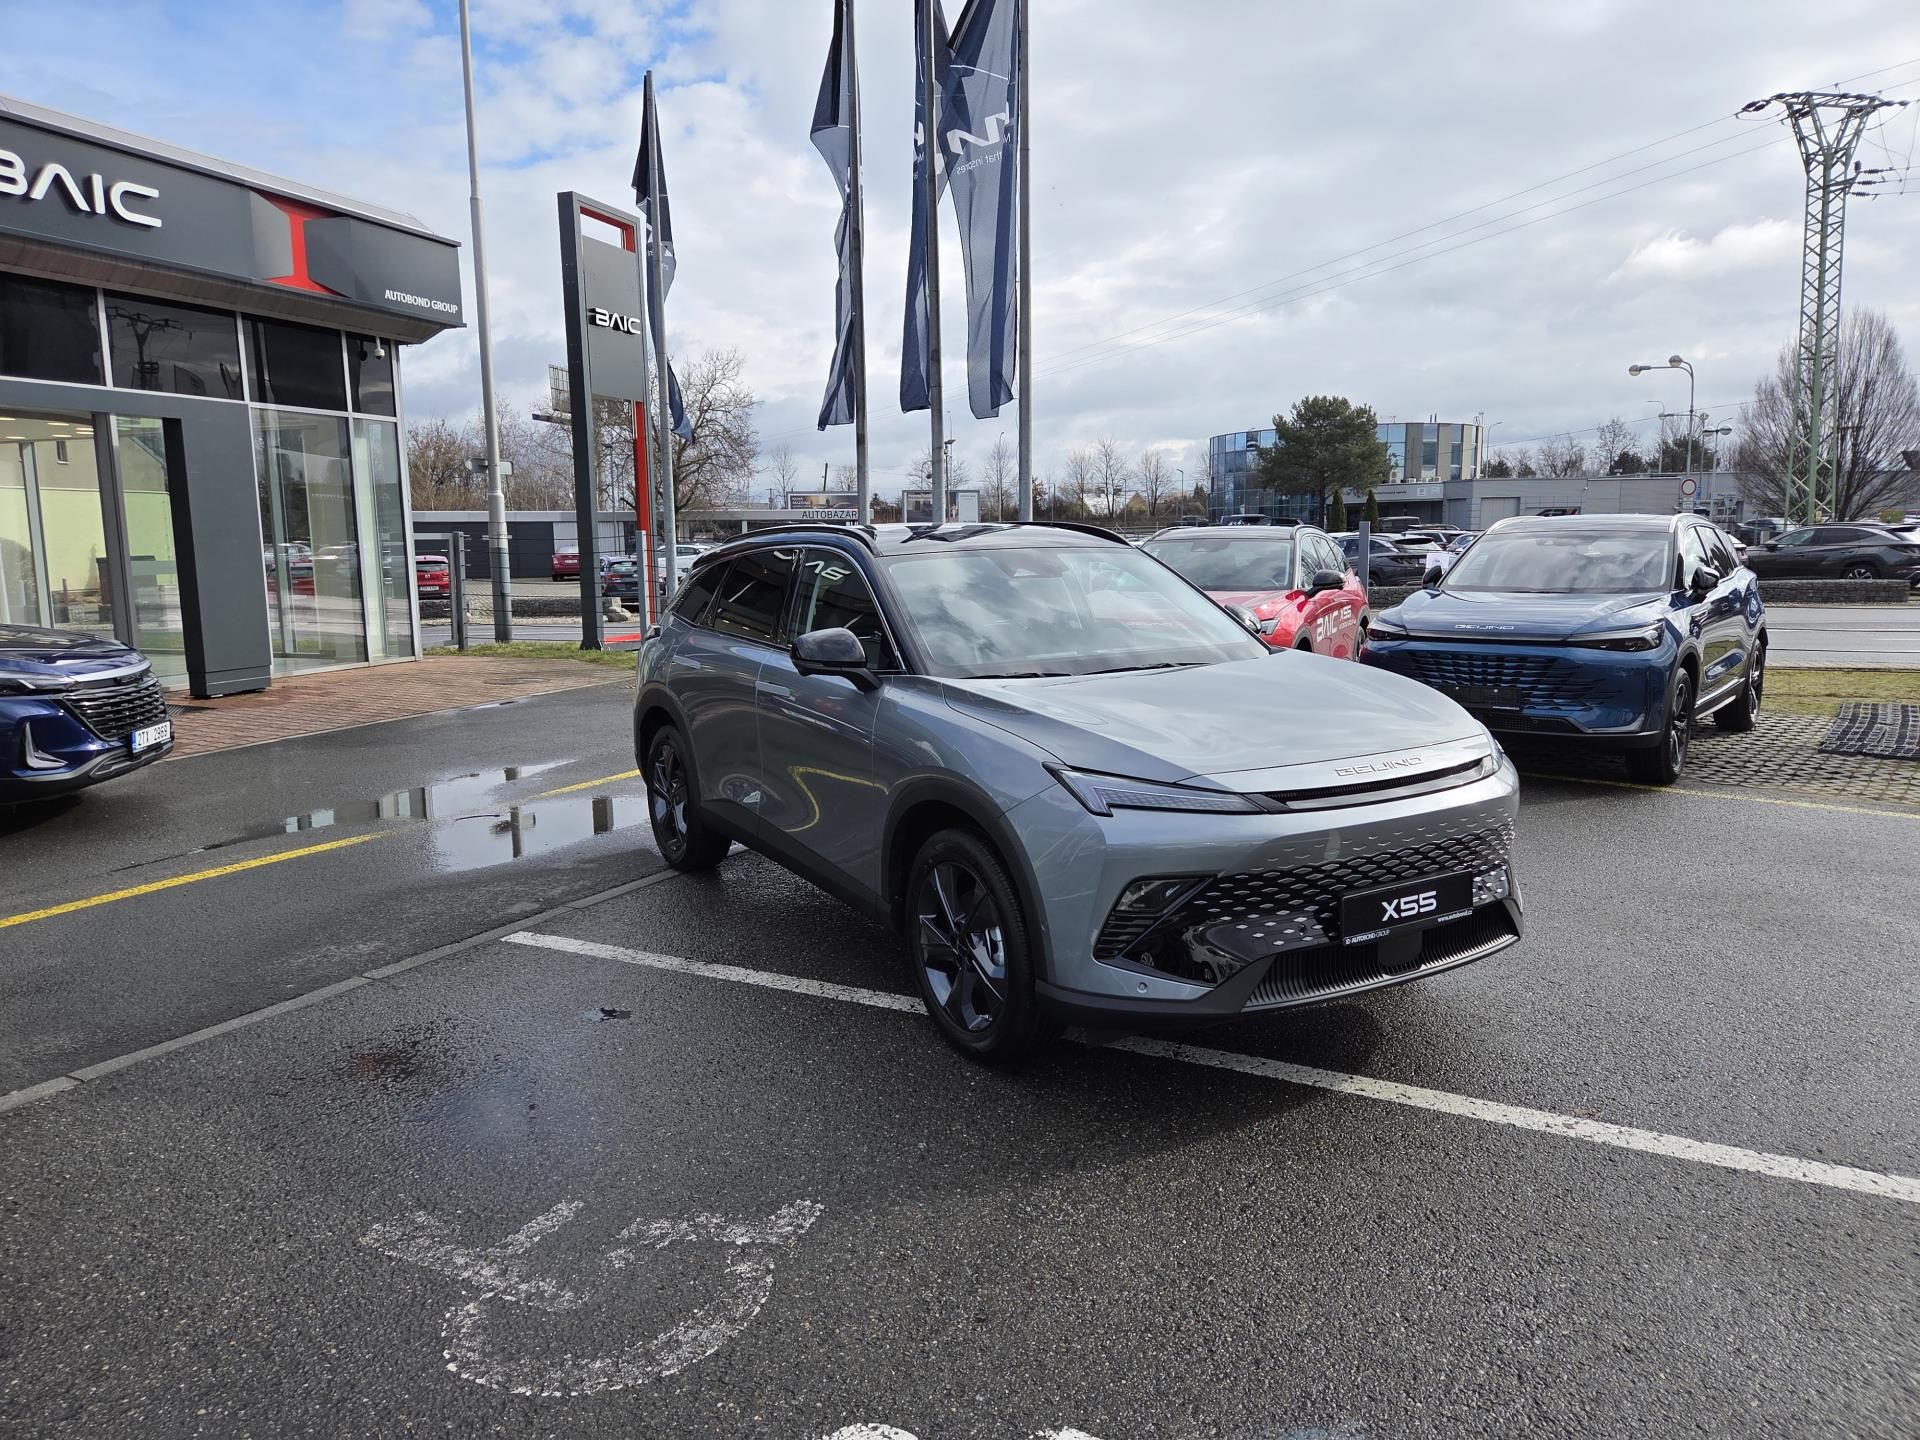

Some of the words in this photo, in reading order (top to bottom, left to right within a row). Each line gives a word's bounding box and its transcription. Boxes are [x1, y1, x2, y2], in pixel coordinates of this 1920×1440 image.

[384, 289, 430, 308] AUTOBOND
[431, 300, 458, 314] GROUP
[595, 307, 641, 335] BAIC
[801, 510, 858, 520] AUTOBAZAR
[1316, 610, 1339, 643] BAIC
[1381, 890, 1437, 922] X55
